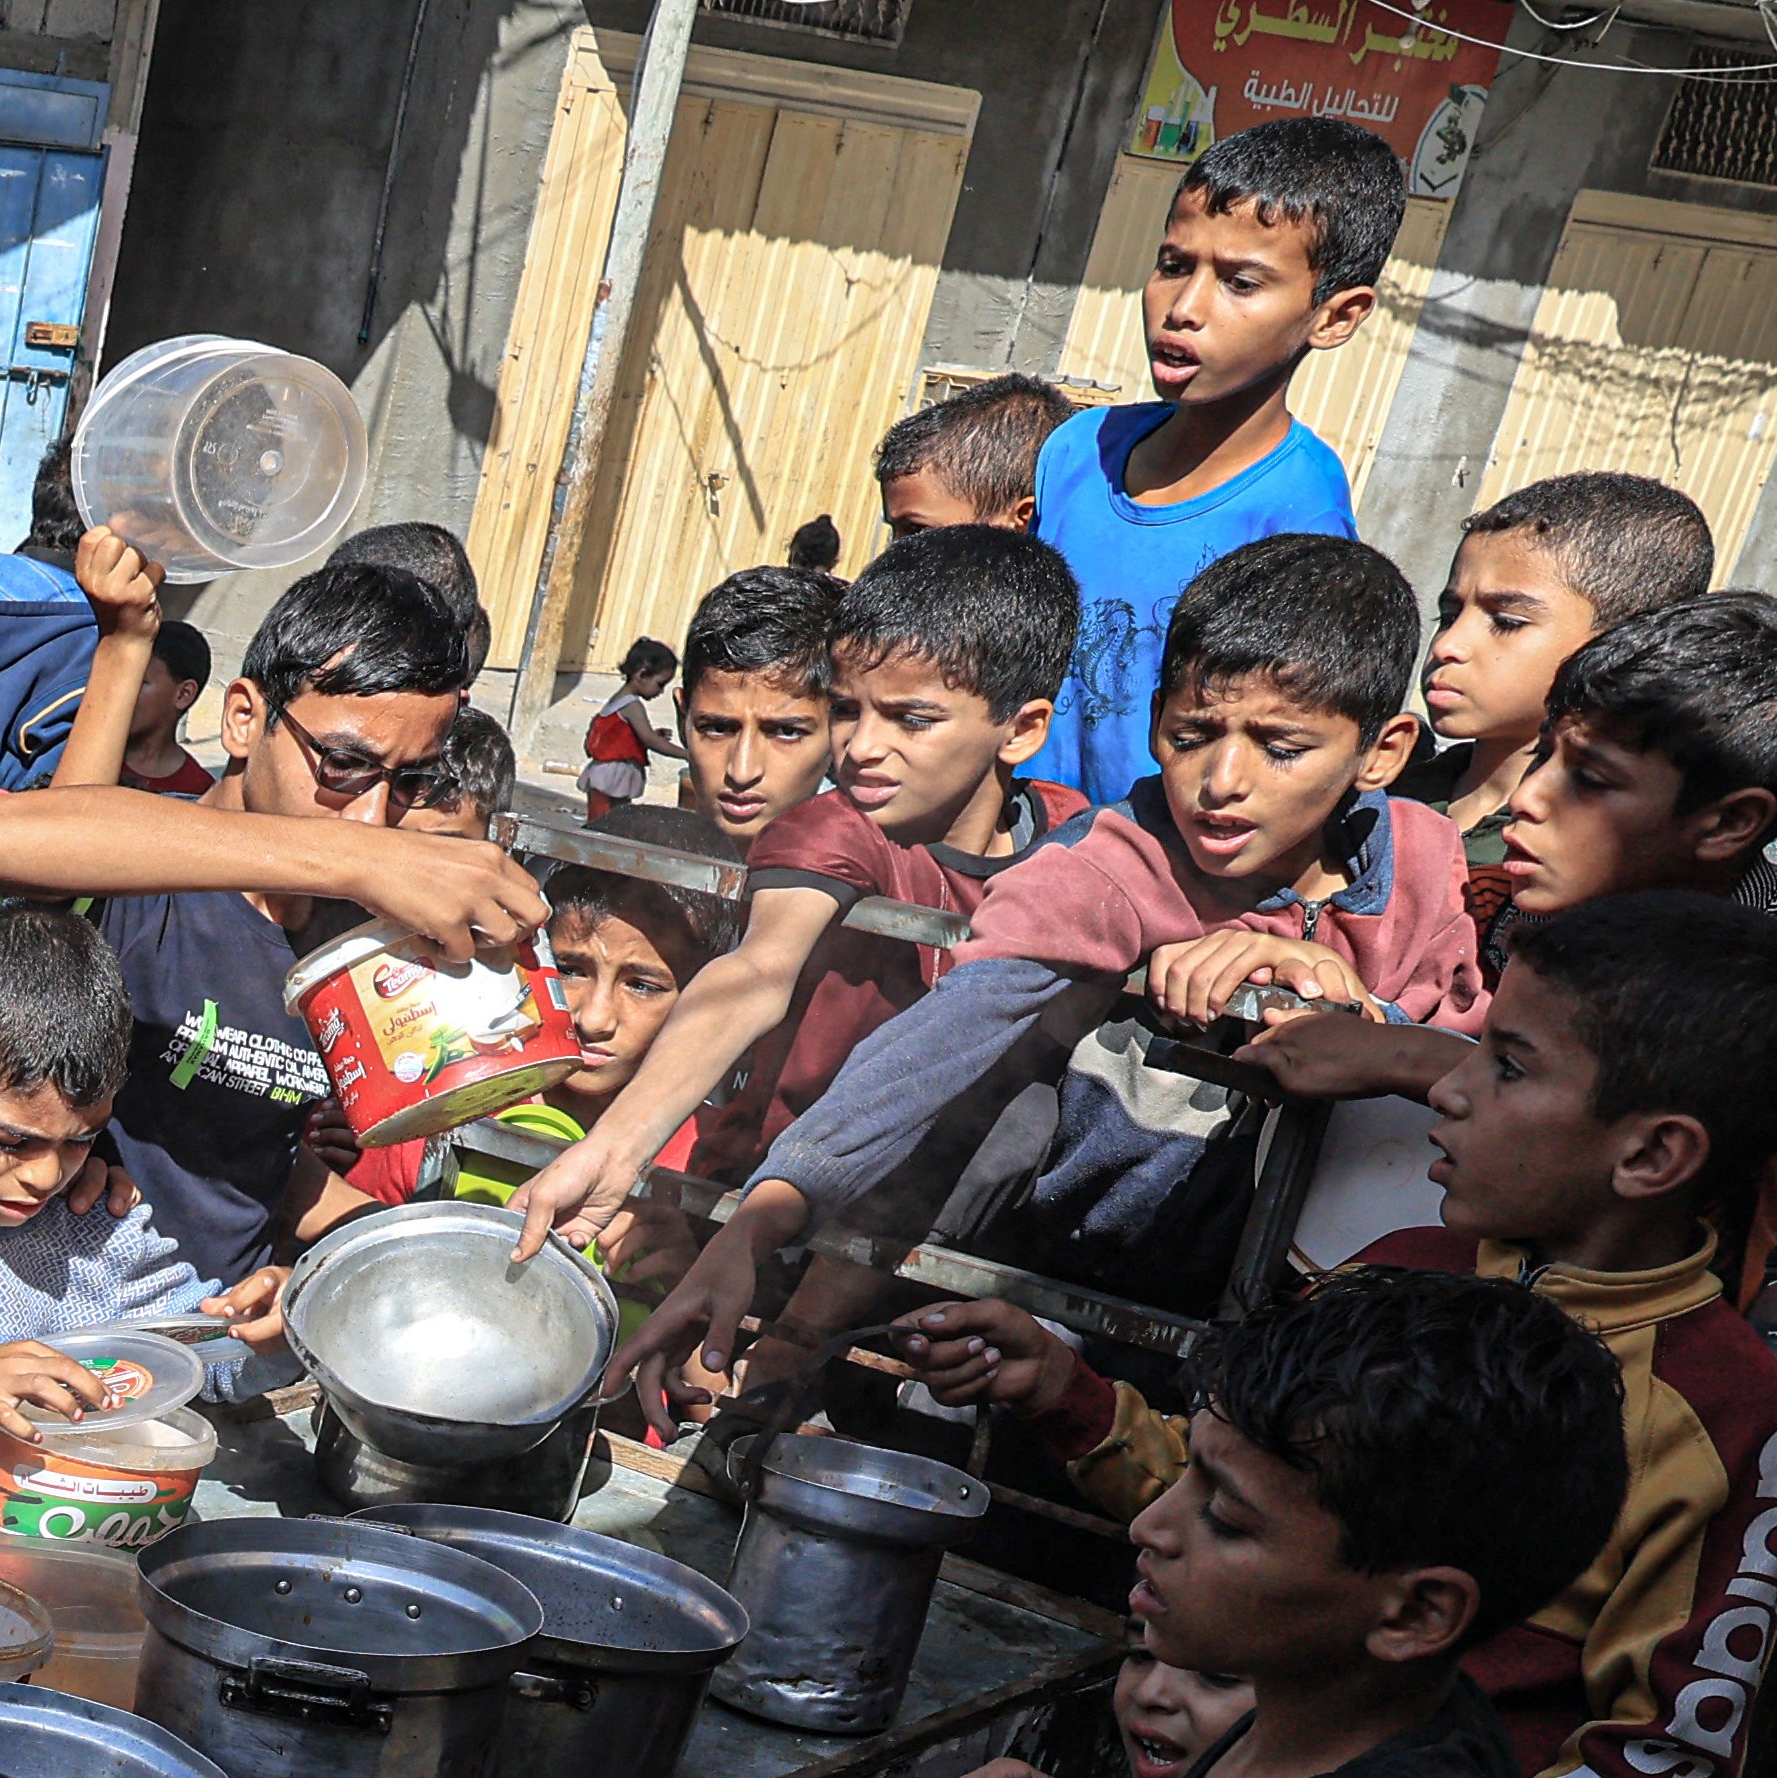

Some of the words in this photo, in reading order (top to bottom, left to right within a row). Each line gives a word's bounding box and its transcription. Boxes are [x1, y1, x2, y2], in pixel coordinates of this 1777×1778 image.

[1243, 68, 1312, 113] الطبية
[1310, 84, 1399, 124] للتحاليل
[20, 1470, 80, 1494] الشام
[82, 1481, 150, 1501] طيبات
